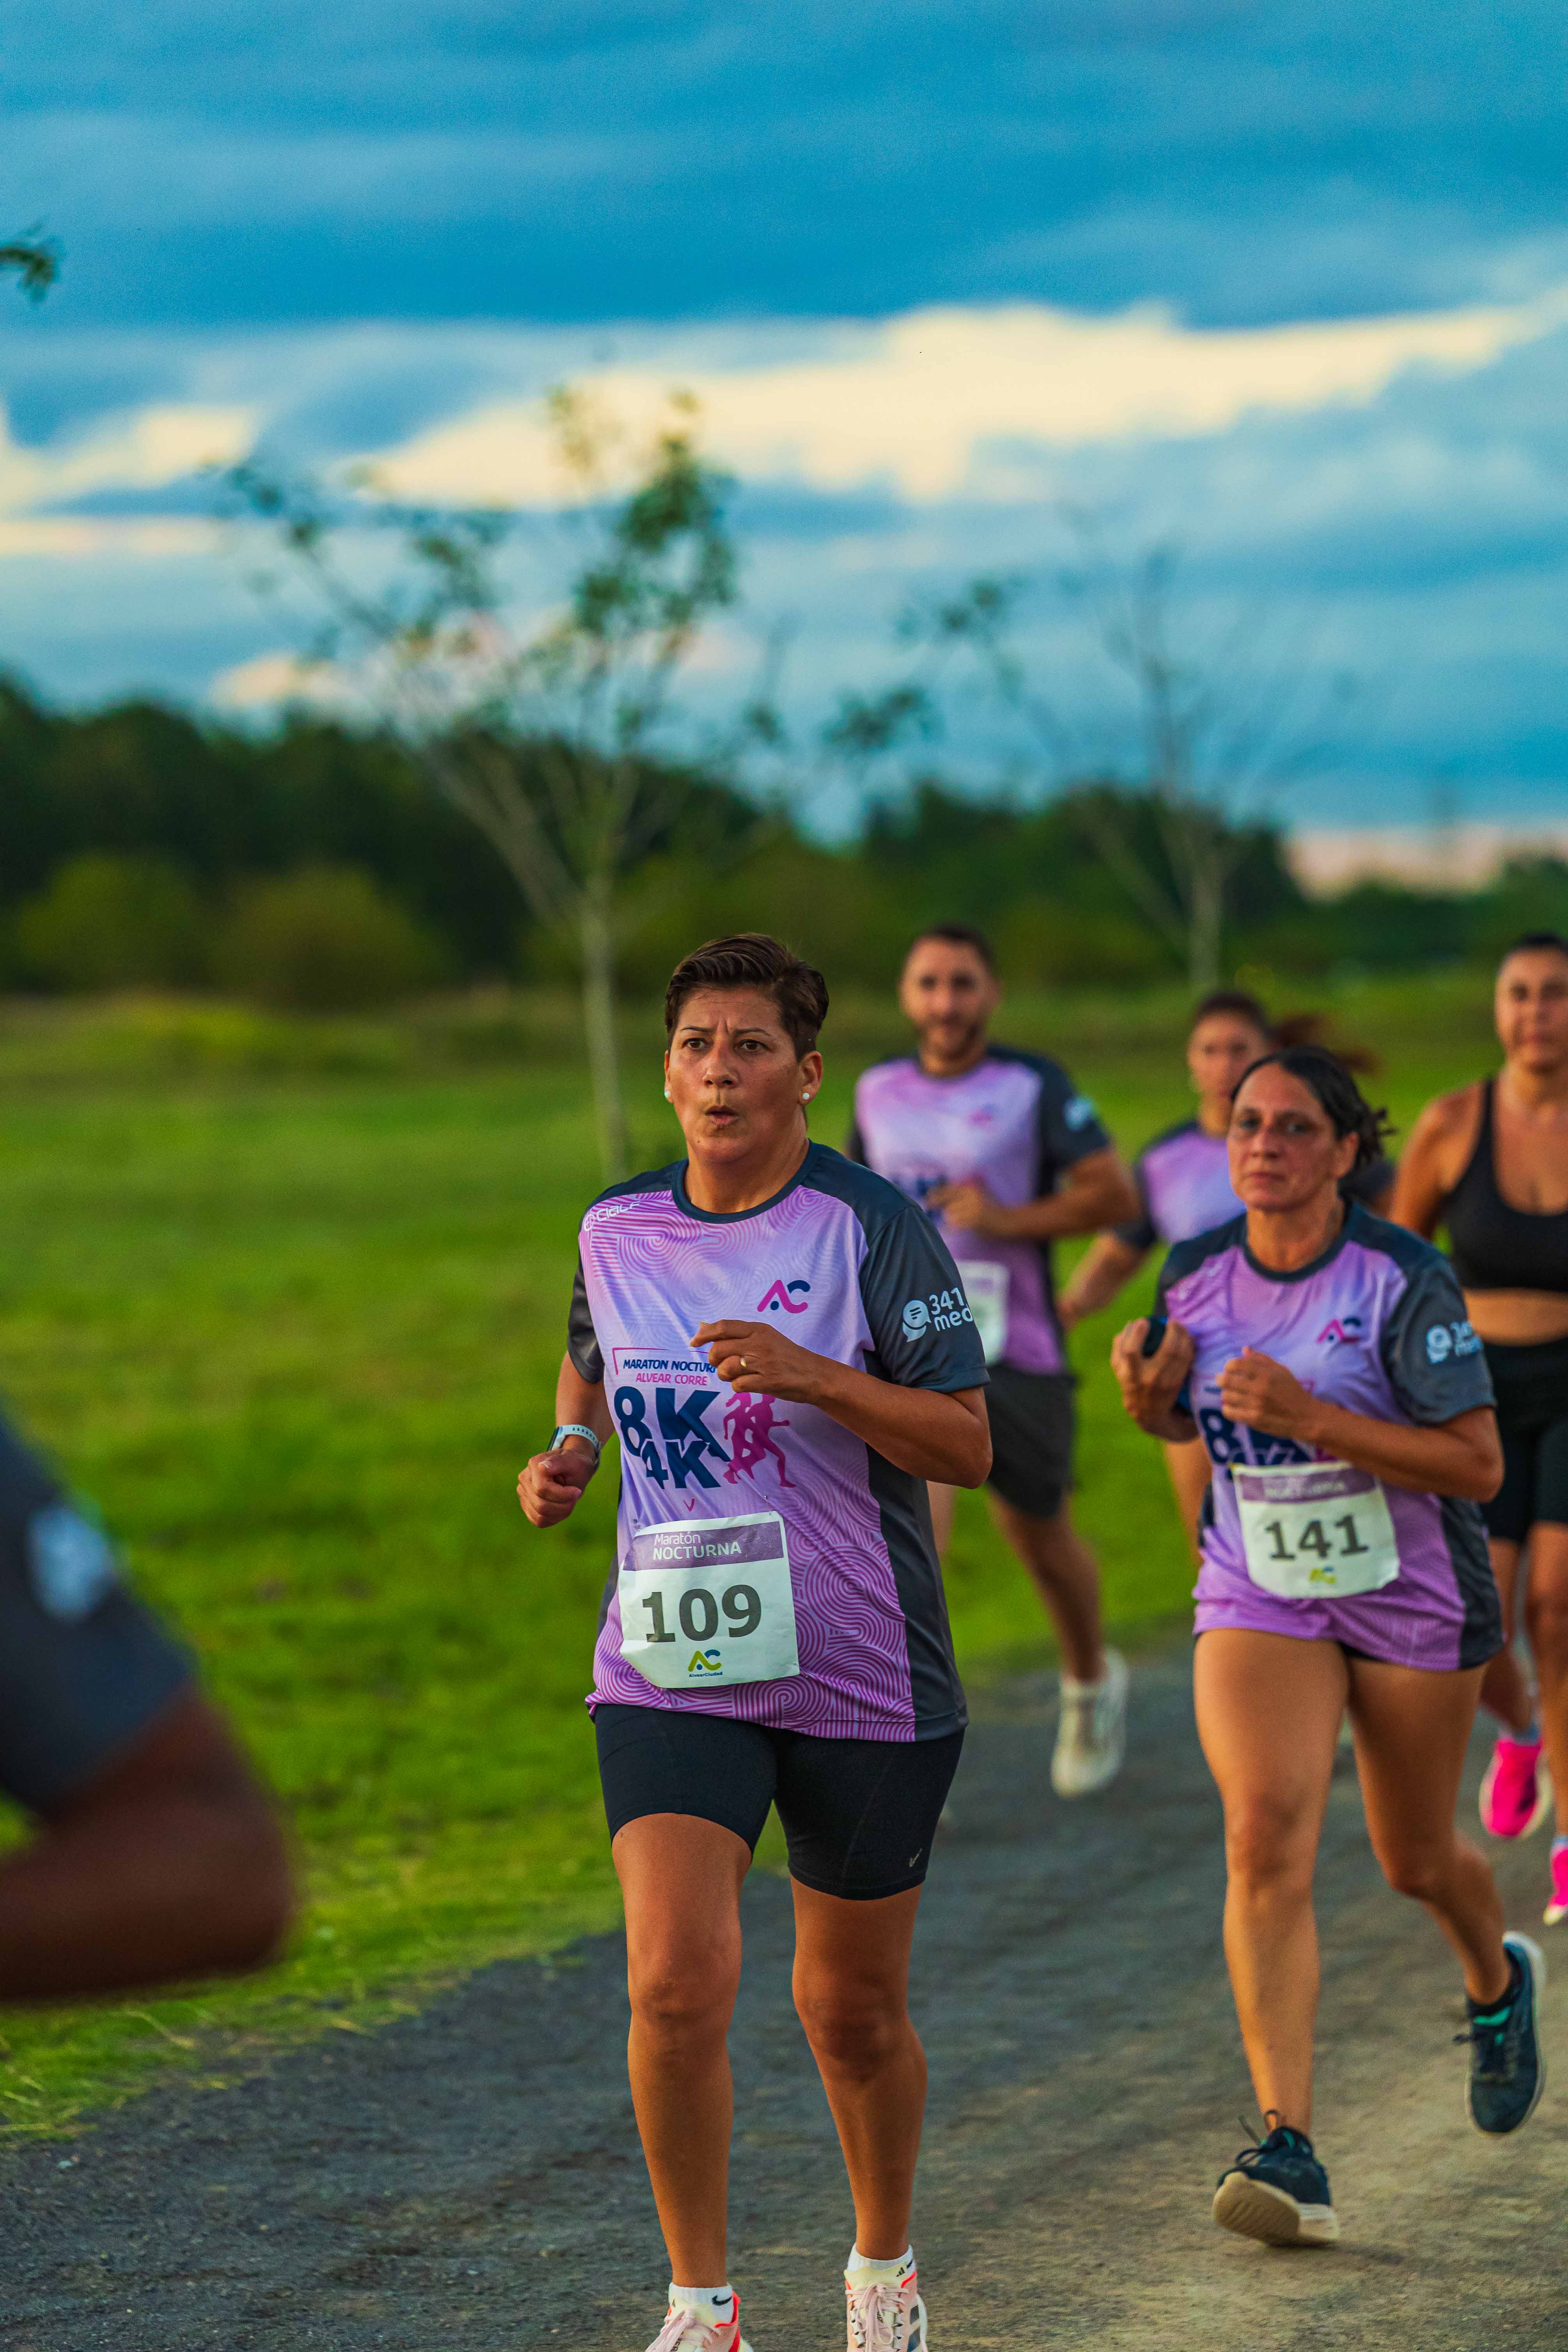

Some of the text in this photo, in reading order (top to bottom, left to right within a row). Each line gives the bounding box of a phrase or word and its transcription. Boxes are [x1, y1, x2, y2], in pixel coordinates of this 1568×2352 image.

[929, 1287, 964, 1315] 341
[623, 1359, 669, 1370] MARATON
[636, 1373, 708, 1386] ALVEAR CORRE
[614, 1386, 731, 1462] 8K
[641, 1440, 721, 1489] 4K
[653, 1541, 742, 1560] NOCTURNA
[654, 1531, 701, 1545] Maratón
[1266, 1514, 1369, 1559] 141
[642, 1584, 762, 1643] 109
